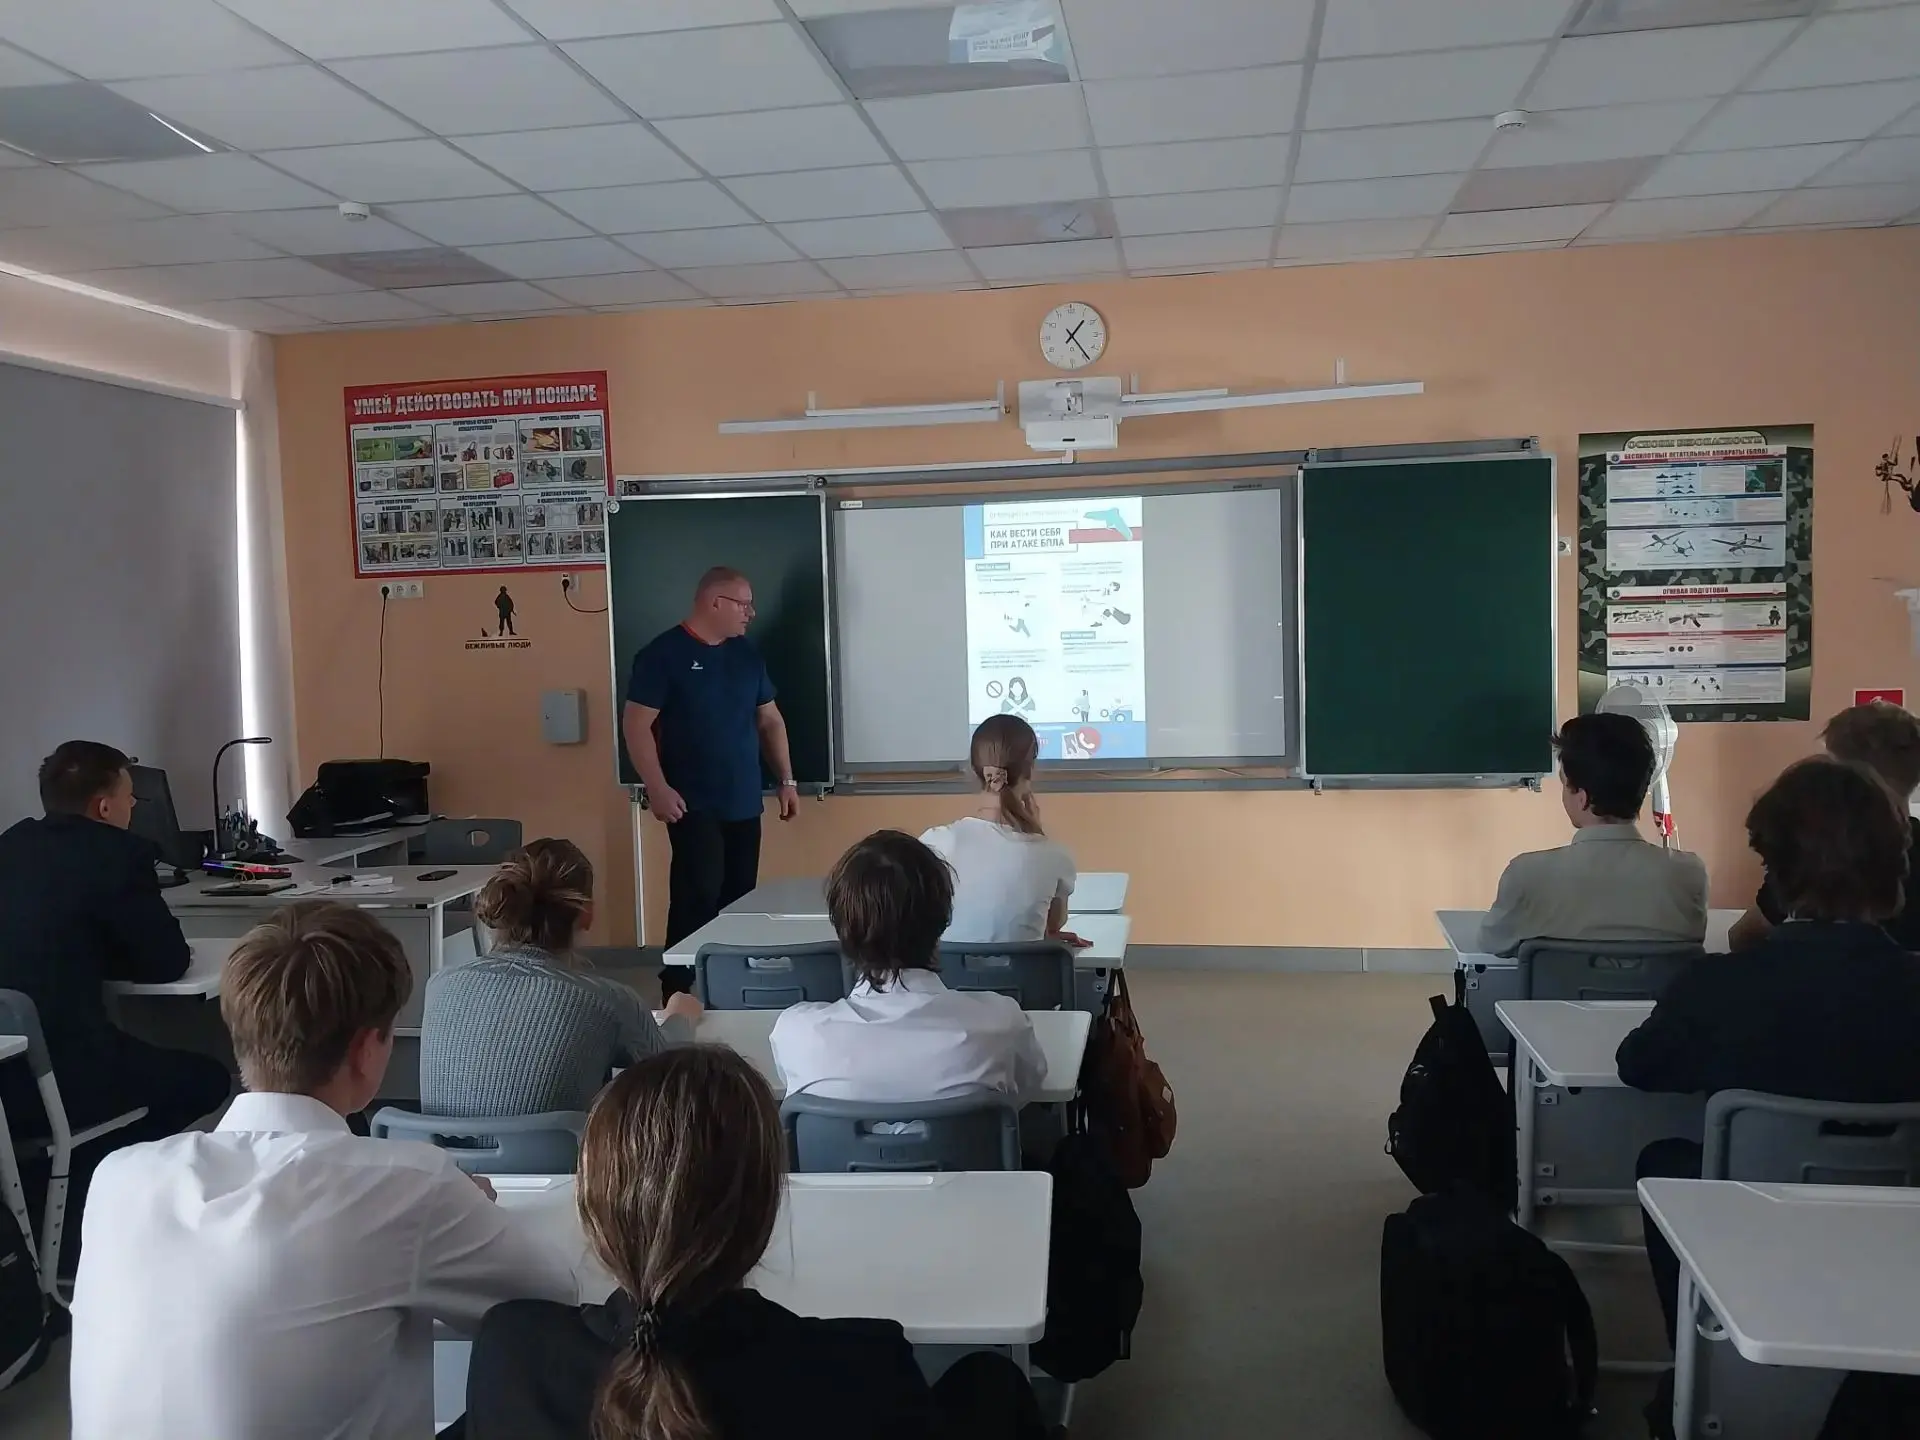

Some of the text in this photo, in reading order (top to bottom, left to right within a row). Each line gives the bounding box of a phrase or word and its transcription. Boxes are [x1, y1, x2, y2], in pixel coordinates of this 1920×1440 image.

[354, 384, 597, 415] УМЕЙ ДЕЙСТВОВАТЬ ПРИ ПОЖАРЕ
[990, 527, 1061, 539] КАК ВЕСТИ СЕБЯ
[990, 538, 1065, 549] ПРИ АТАКЕ БПЛА
[1662, 587, 1688, 595] ОГНЕВАЯ
[465, 641, 532, 650] ВЕЖЛИВЫЕ ЛЮДИ
